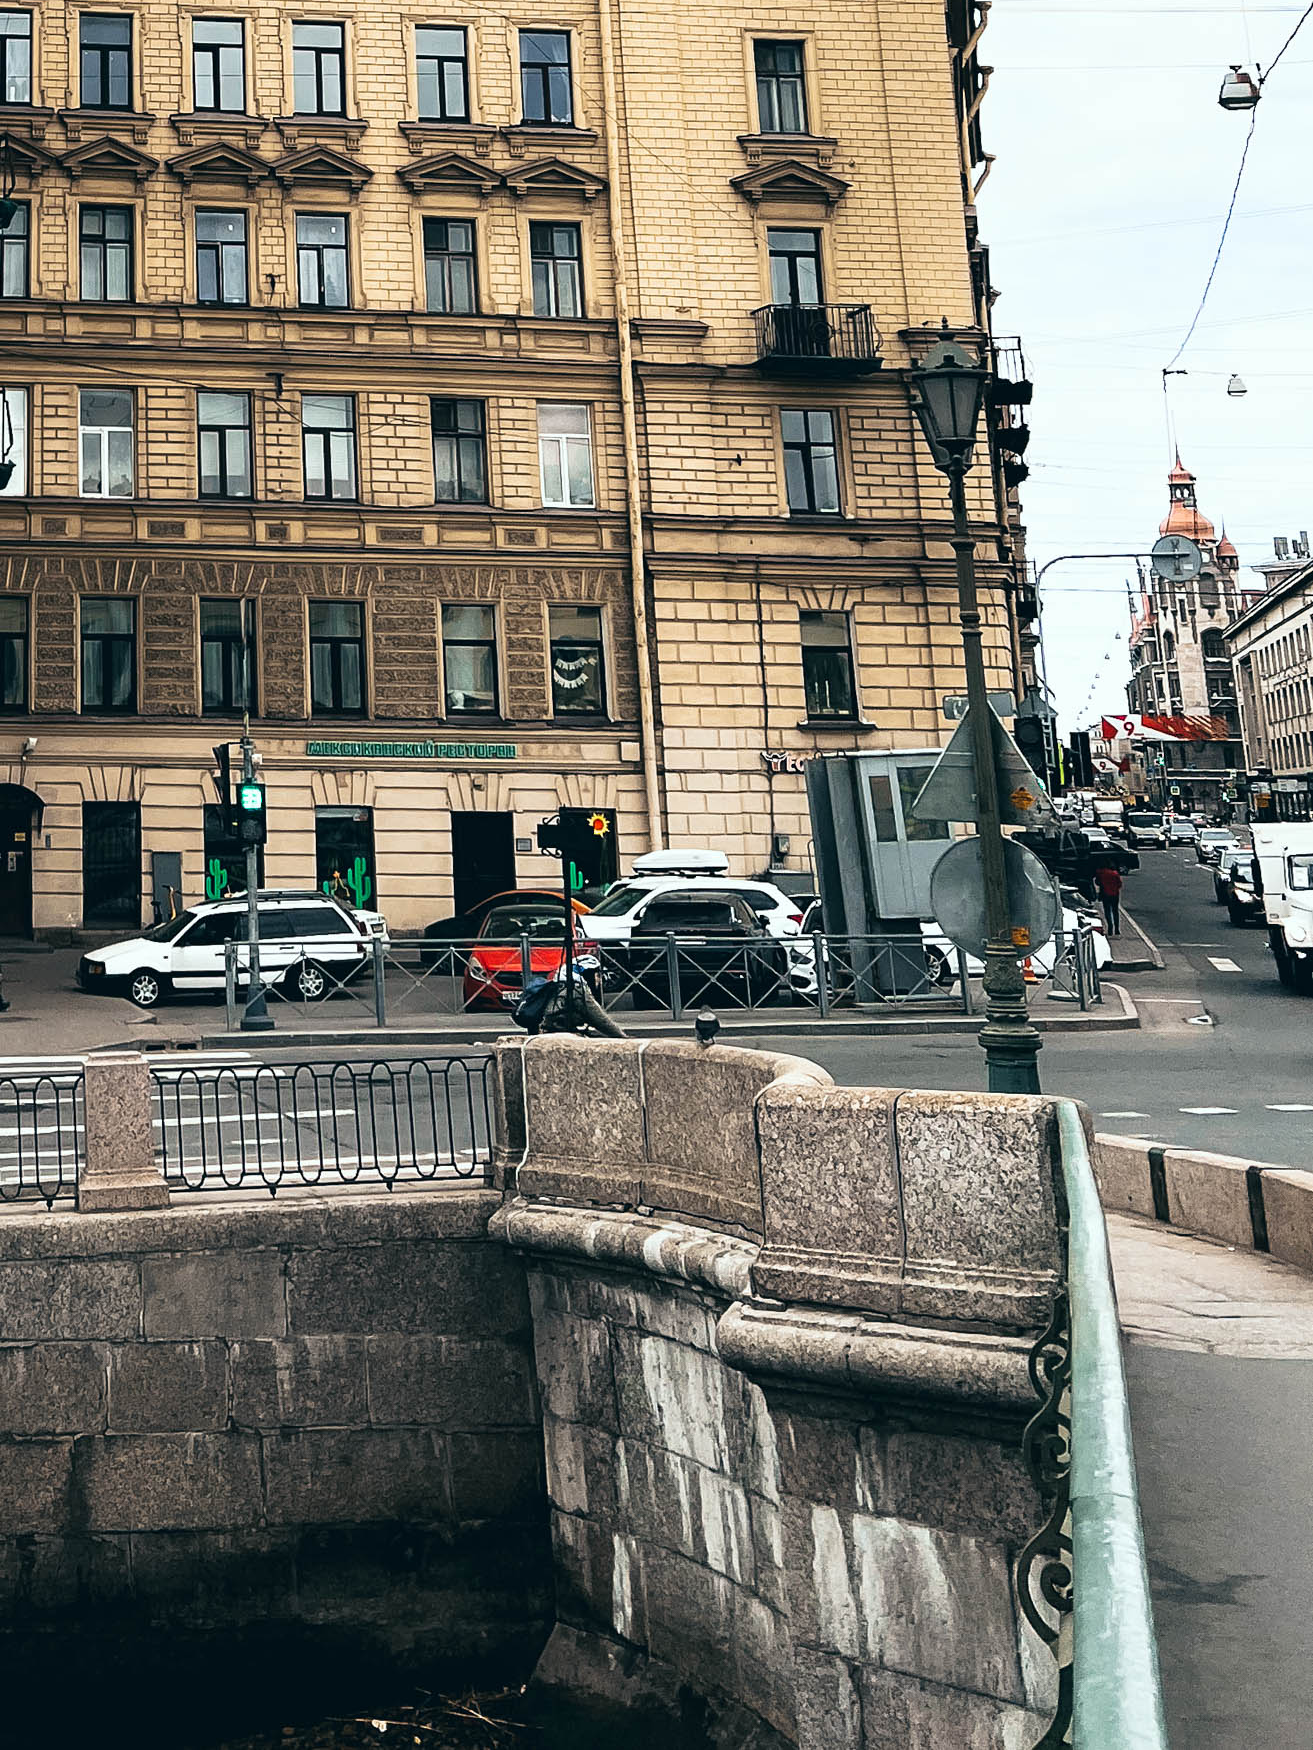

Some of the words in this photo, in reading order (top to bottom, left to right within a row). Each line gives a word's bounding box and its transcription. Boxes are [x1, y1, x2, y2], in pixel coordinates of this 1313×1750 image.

[1124, 722, 1134, 736] 9
[307, 739, 434, 757] МЕКСИКАНСКИЙ
[437, 742, 517, 759] РЕСТОРАН
